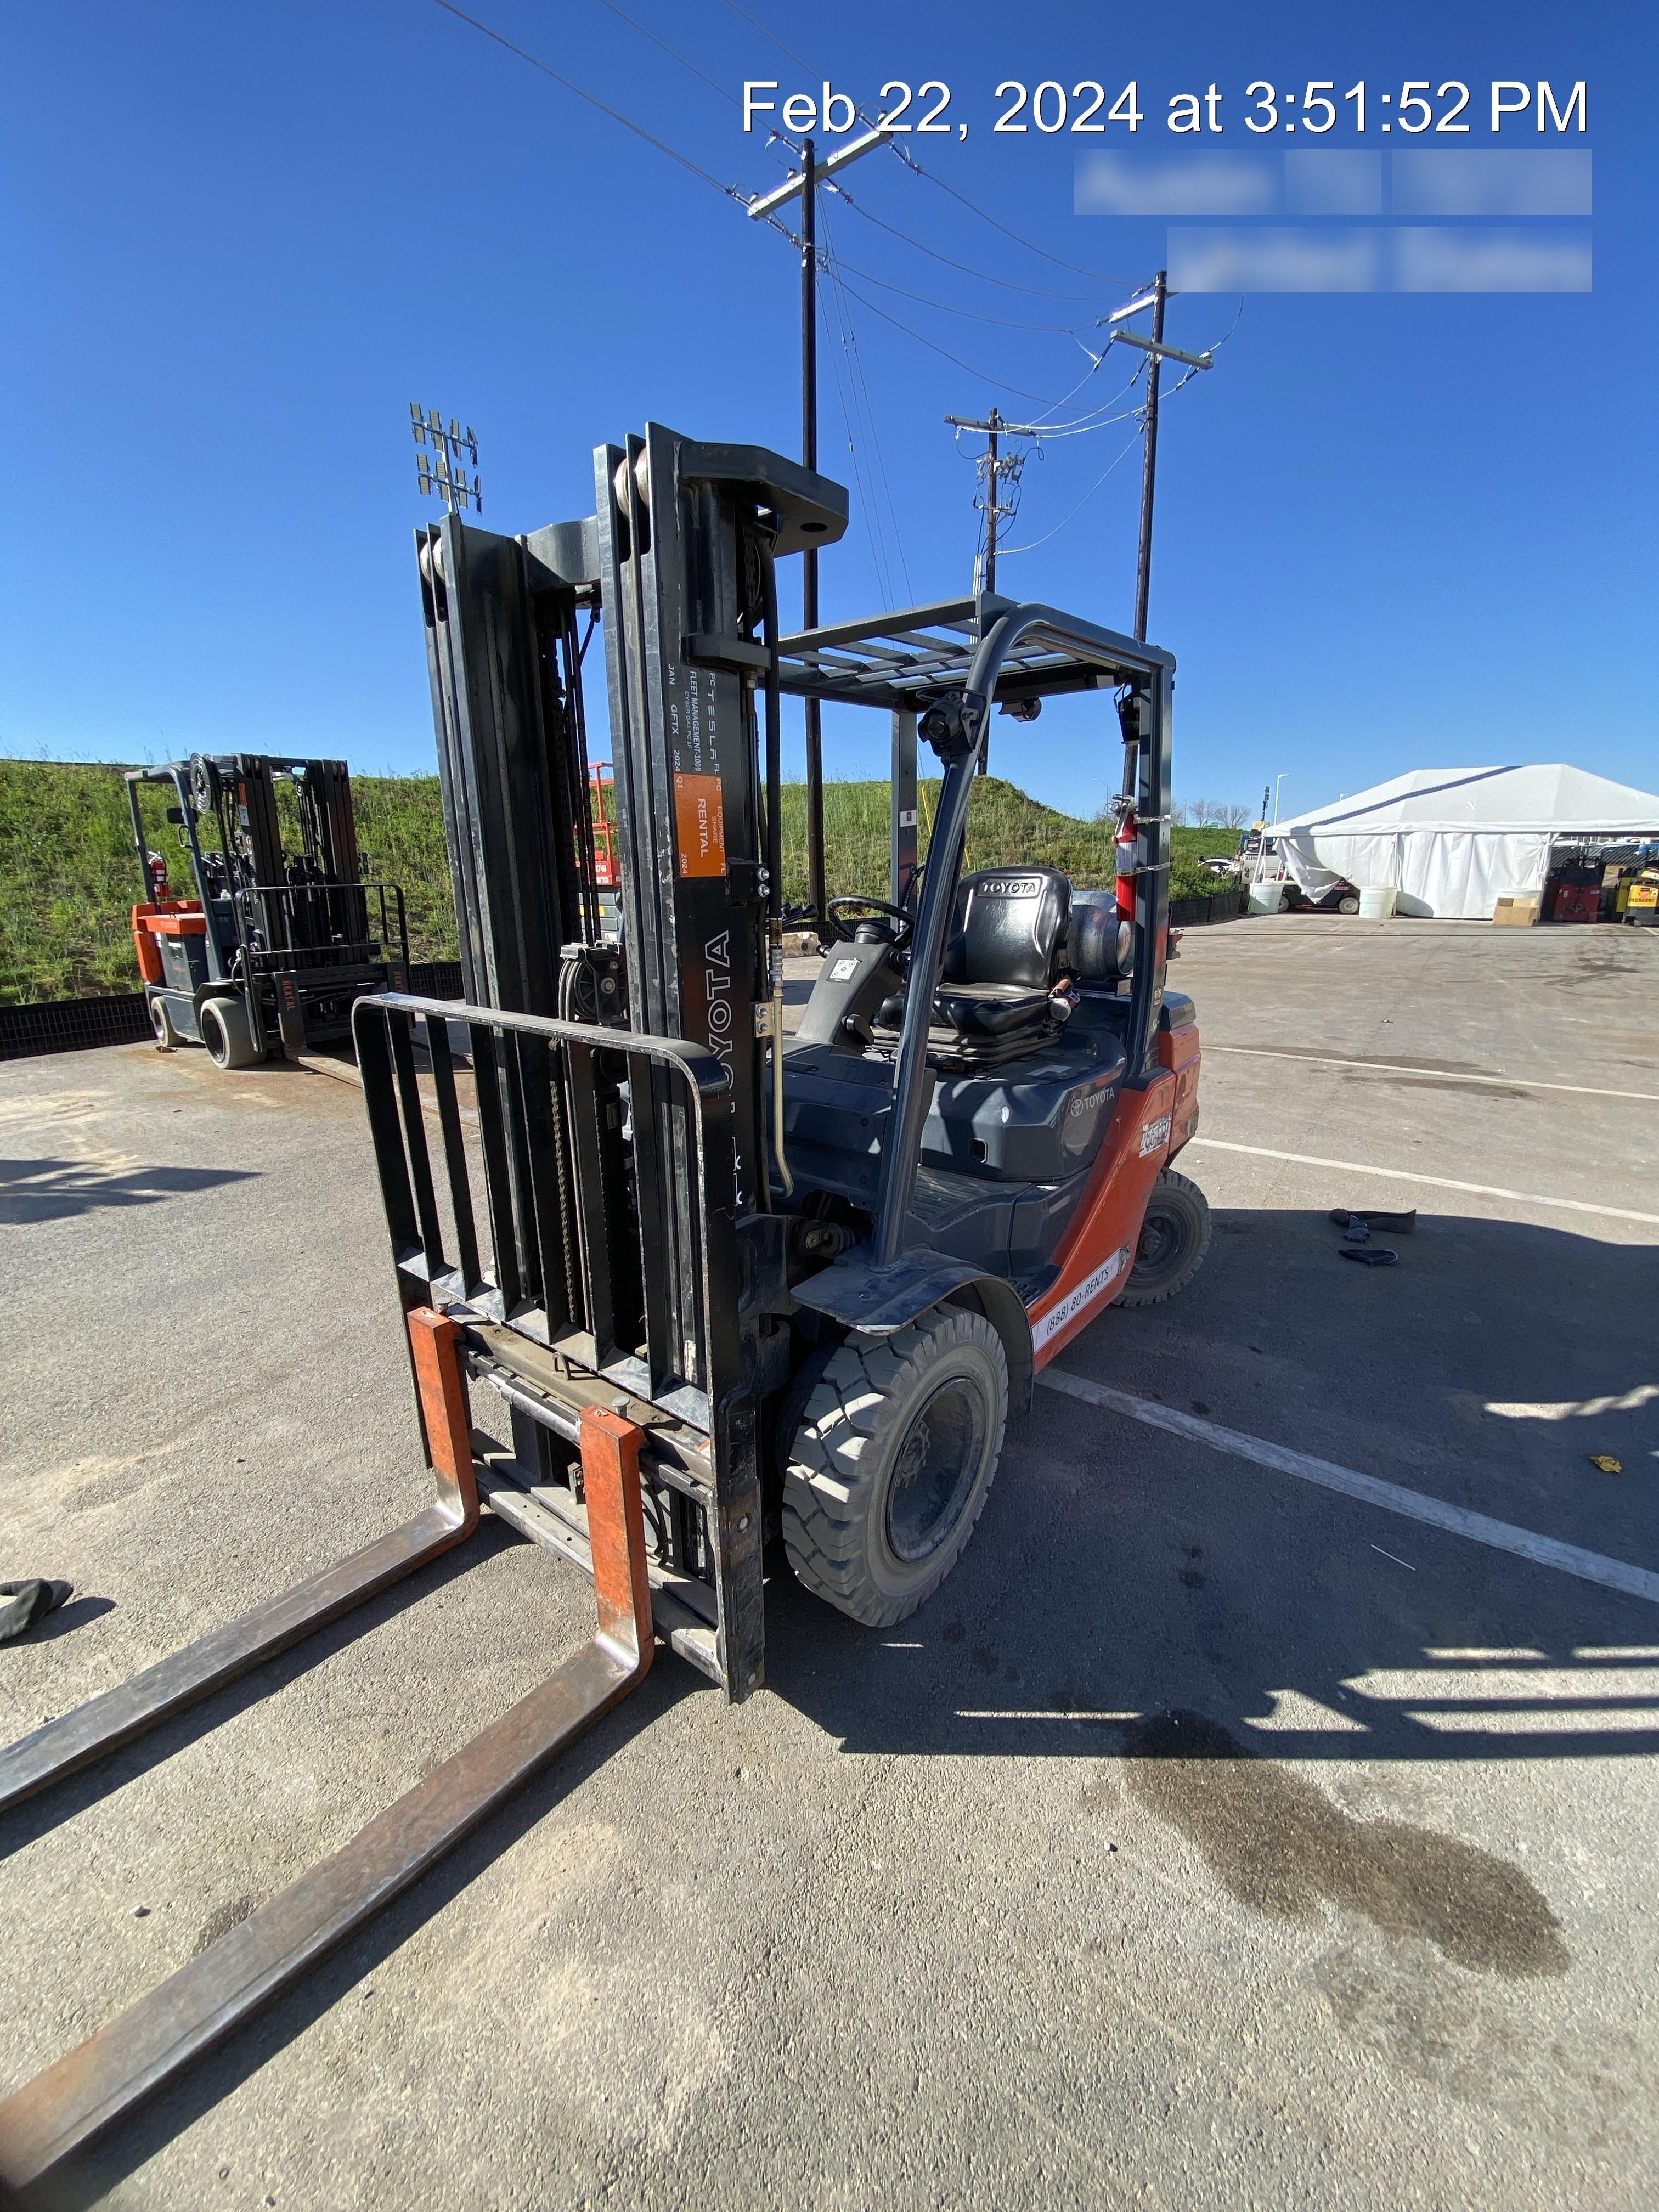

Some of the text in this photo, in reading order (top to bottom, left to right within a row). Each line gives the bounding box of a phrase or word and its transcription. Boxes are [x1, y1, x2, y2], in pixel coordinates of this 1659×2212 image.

[668, 663, 681, 772] JAN GFTX 2024
[686, 731, 692, 740] PC
[691, 697, 702, 772] MANAGEMENT-1009
[708, 672, 720, 774] PC TESLA FL
[676, 775, 684, 789] Q1
[697, 798, 709, 858] RENTAL
[716, 778, 721, 792] PC
[720, 862, 726, 874] FL
[983, 882, 1036, 894] TOYOTA
[1084, 1087, 1115, 1110] TOYOTA
[1047, 1266, 1109, 1336] (888) 80-RENTS
